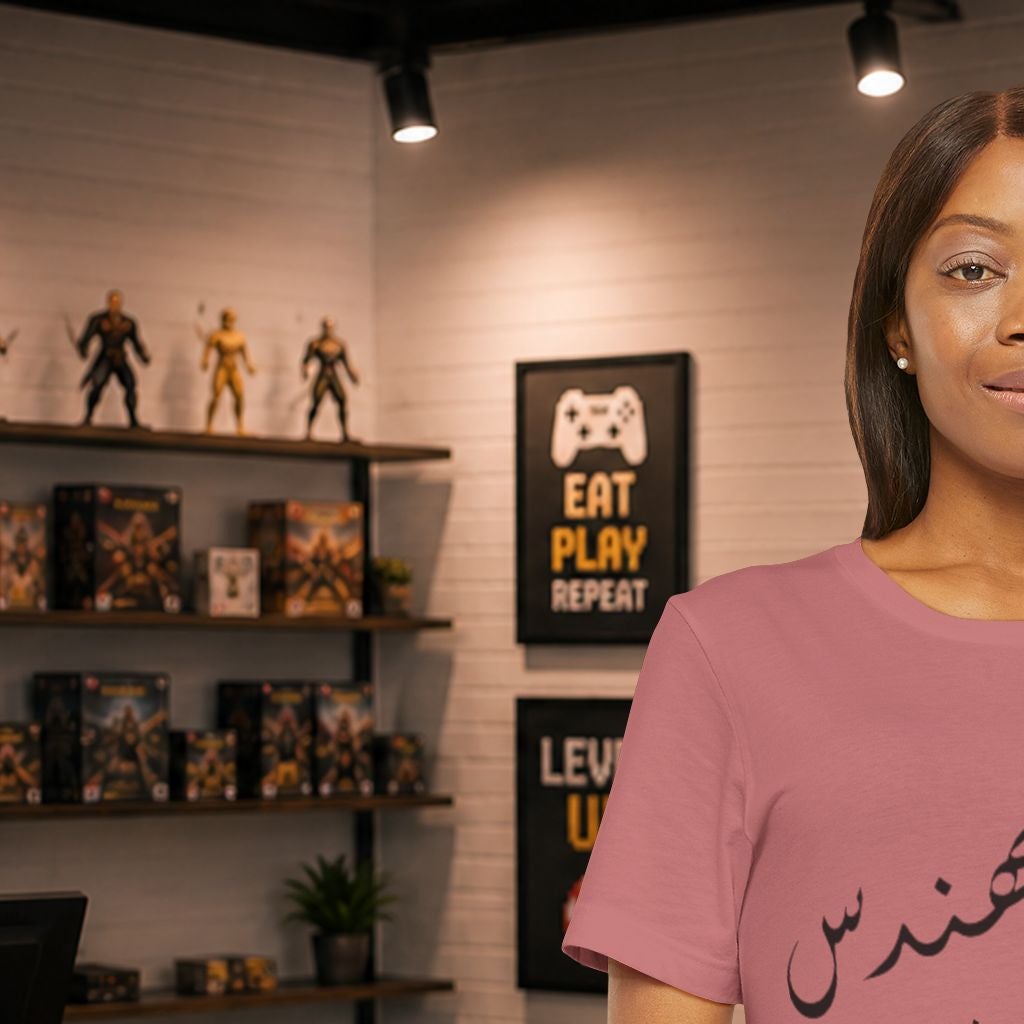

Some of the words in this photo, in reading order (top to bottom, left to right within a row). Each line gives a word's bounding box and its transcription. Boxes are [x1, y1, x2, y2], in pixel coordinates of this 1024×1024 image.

[563, 470, 636, 519] EAT
[551, 525, 648, 573] PLAY
[551, 578, 648, 613] REPEAT
[540, 736, 623, 787] LEV
[566, 793, 609, 852] U
